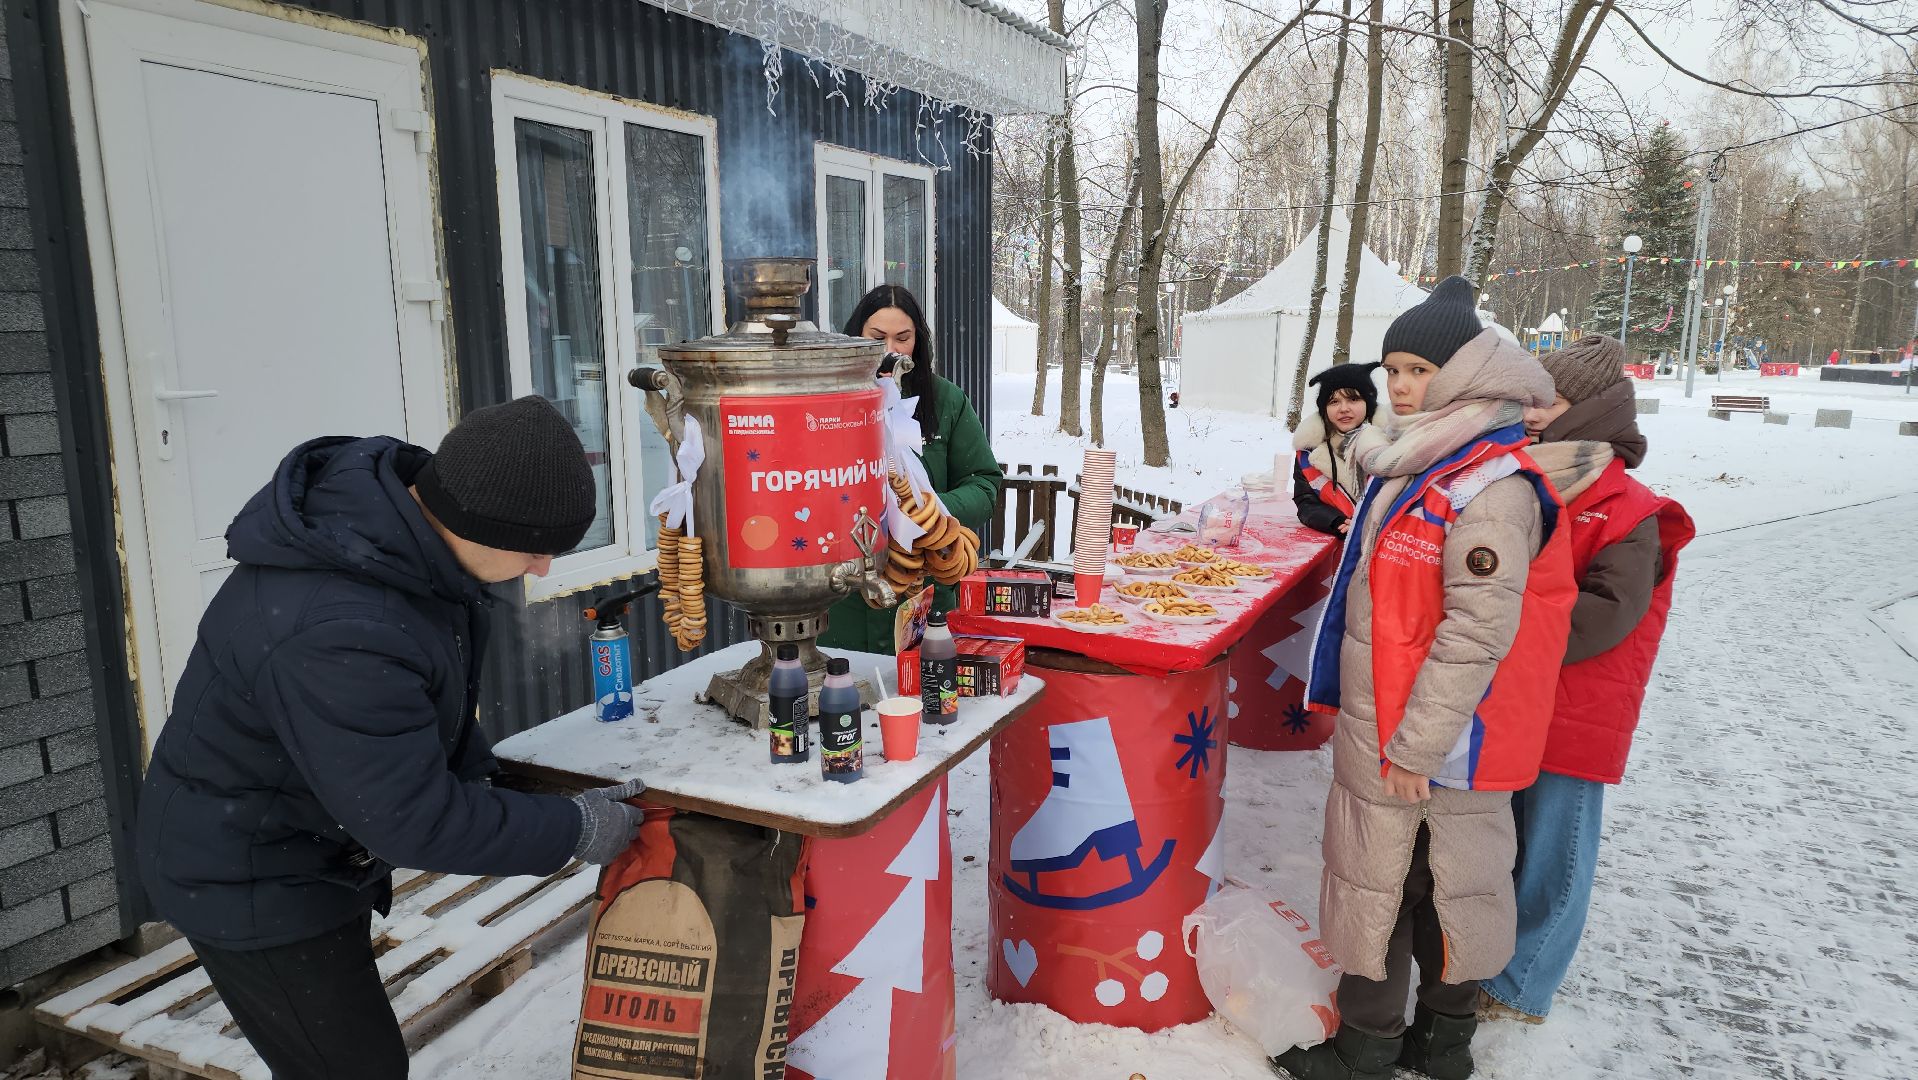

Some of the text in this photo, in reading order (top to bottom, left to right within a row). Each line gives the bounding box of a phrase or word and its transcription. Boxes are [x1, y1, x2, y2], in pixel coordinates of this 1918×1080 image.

[728, 414, 775, 428] ЗИМА
[819, 416, 841, 424] ПАРКИ
[751, 457, 887, 493] ГОРЯЧИЙ ЧА
[598, 645, 613, 677] GAS
[836, 732, 857, 743] ГРОГ
[597, 952, 702, 987] ДРЕВЕСНЫЙ
[603, 992, 676, 1023] УГОЛЬ
[582, 1032, 632, 1050] ПРЕДНАЗНАЧЕН
[631, 1039, 652, 1052] ДЛЯ
